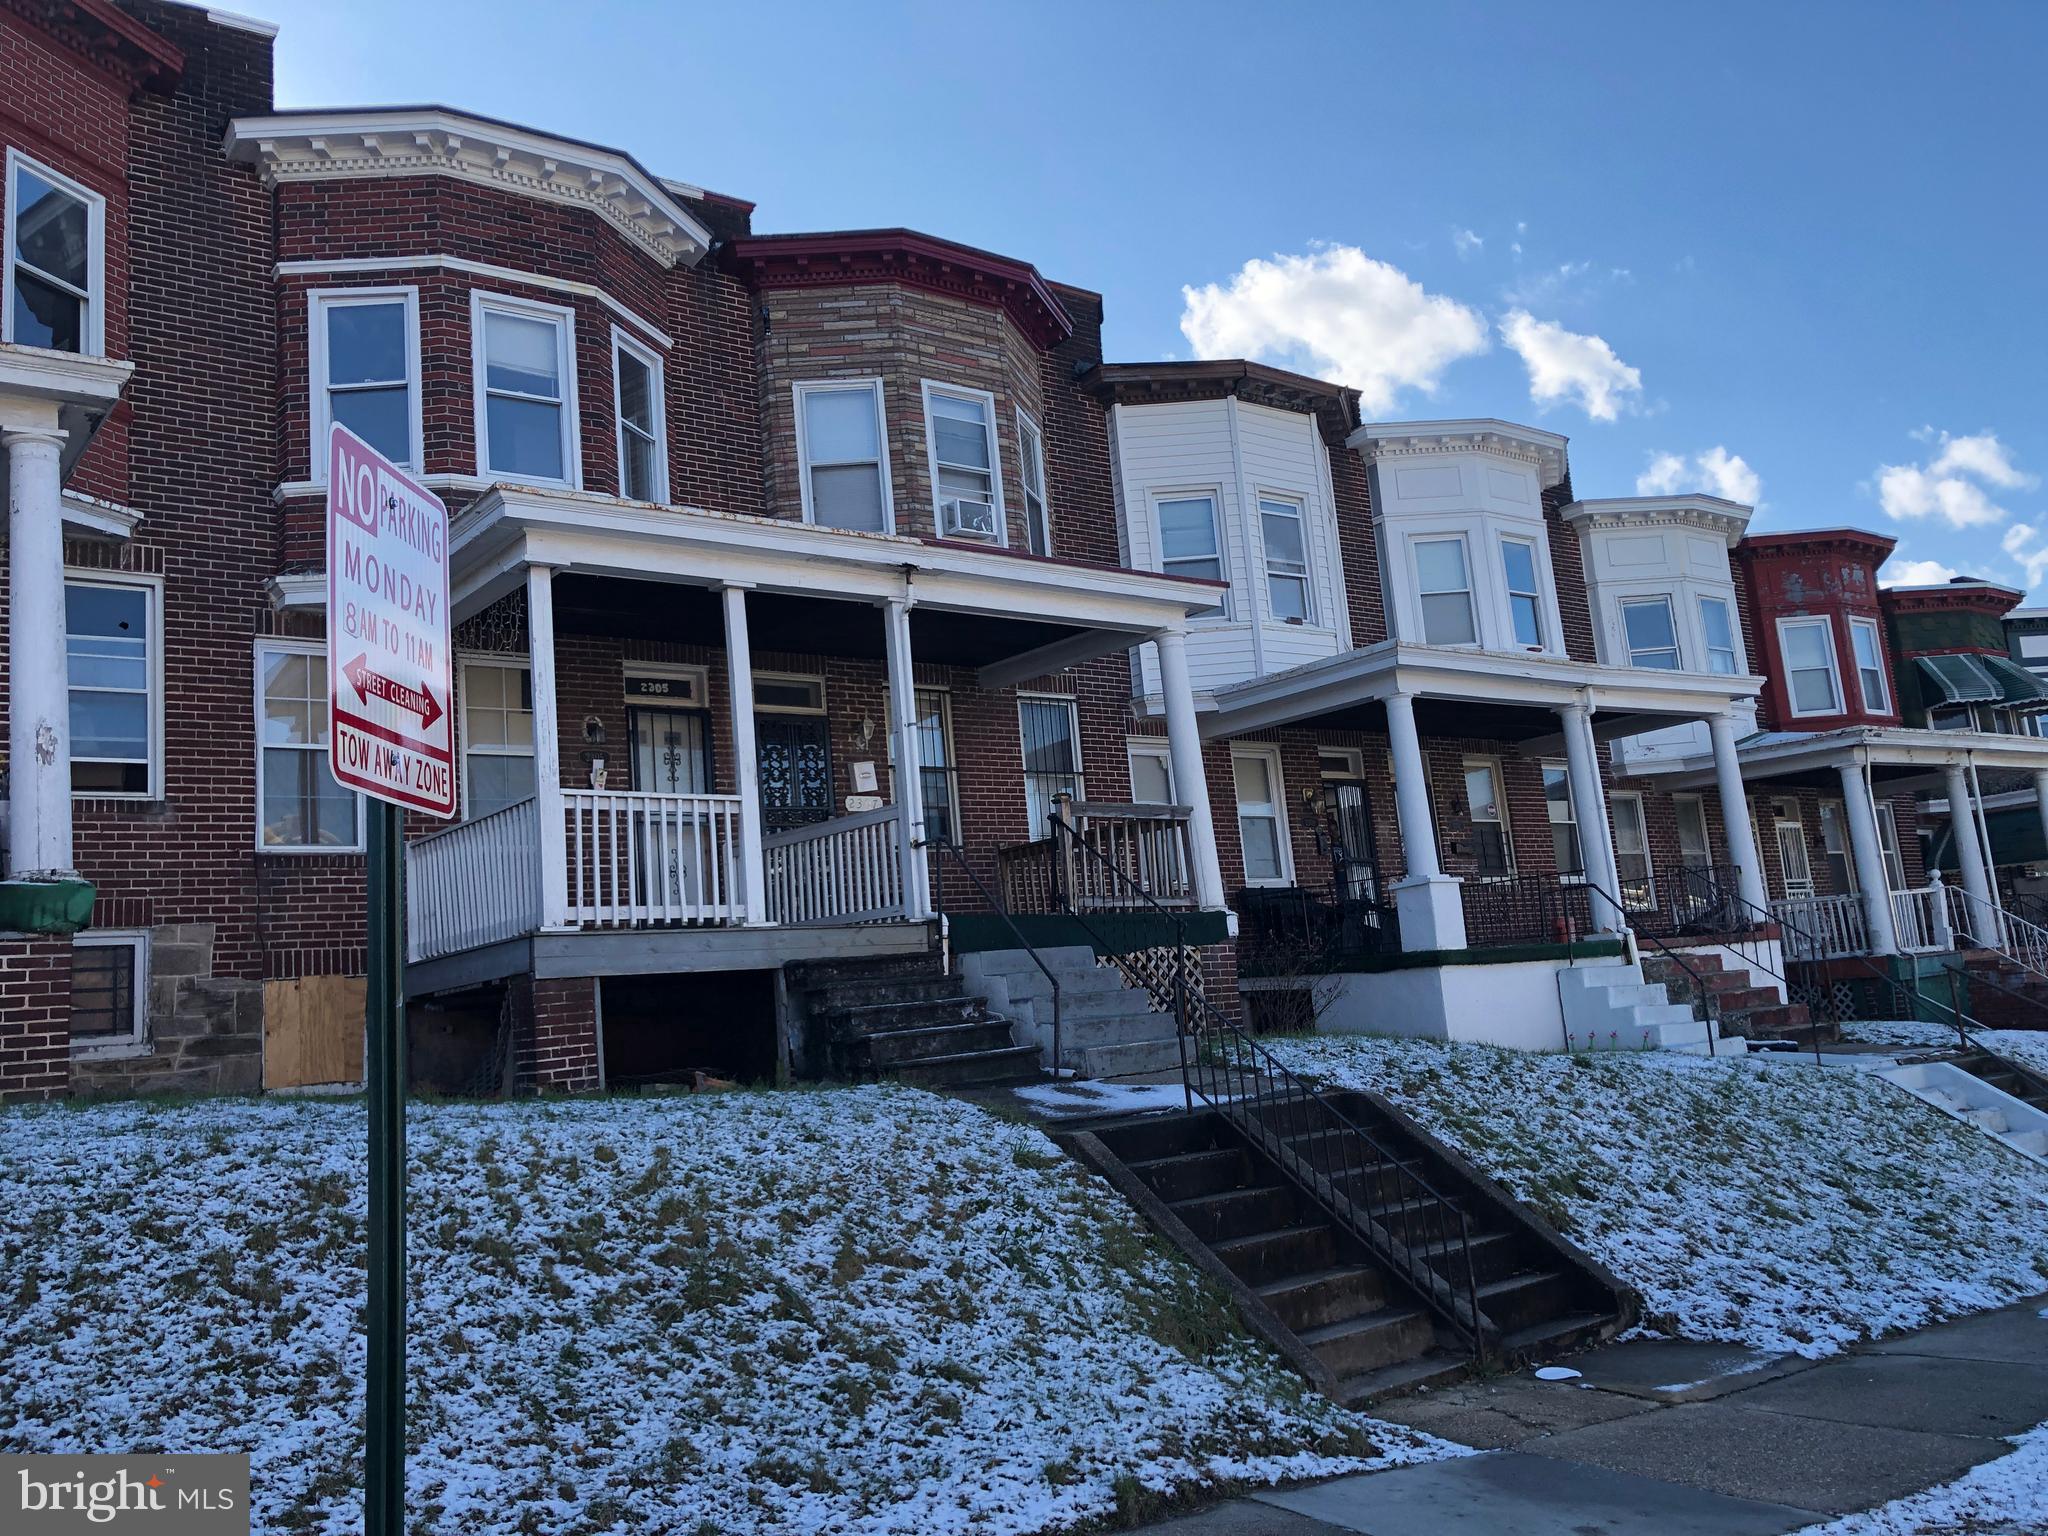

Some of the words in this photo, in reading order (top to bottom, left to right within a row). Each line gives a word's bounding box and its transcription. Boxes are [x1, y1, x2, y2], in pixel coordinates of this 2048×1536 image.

[338, 447, 375, 527] NO
[380, 483, 441, 564] PARKING
[344, 540, 437, 626] MONDAY
[382, 618, 399, 655] TO
[356, 668, 387, 697] STREET
[390, 683, 430, 716] CLEANING
[640, 682, 669, 694] 2305
[340, 730, 370, 772] TOW
[374, 744, 411, 786] AWAY
[416, 759, 448, 798] ZONE
